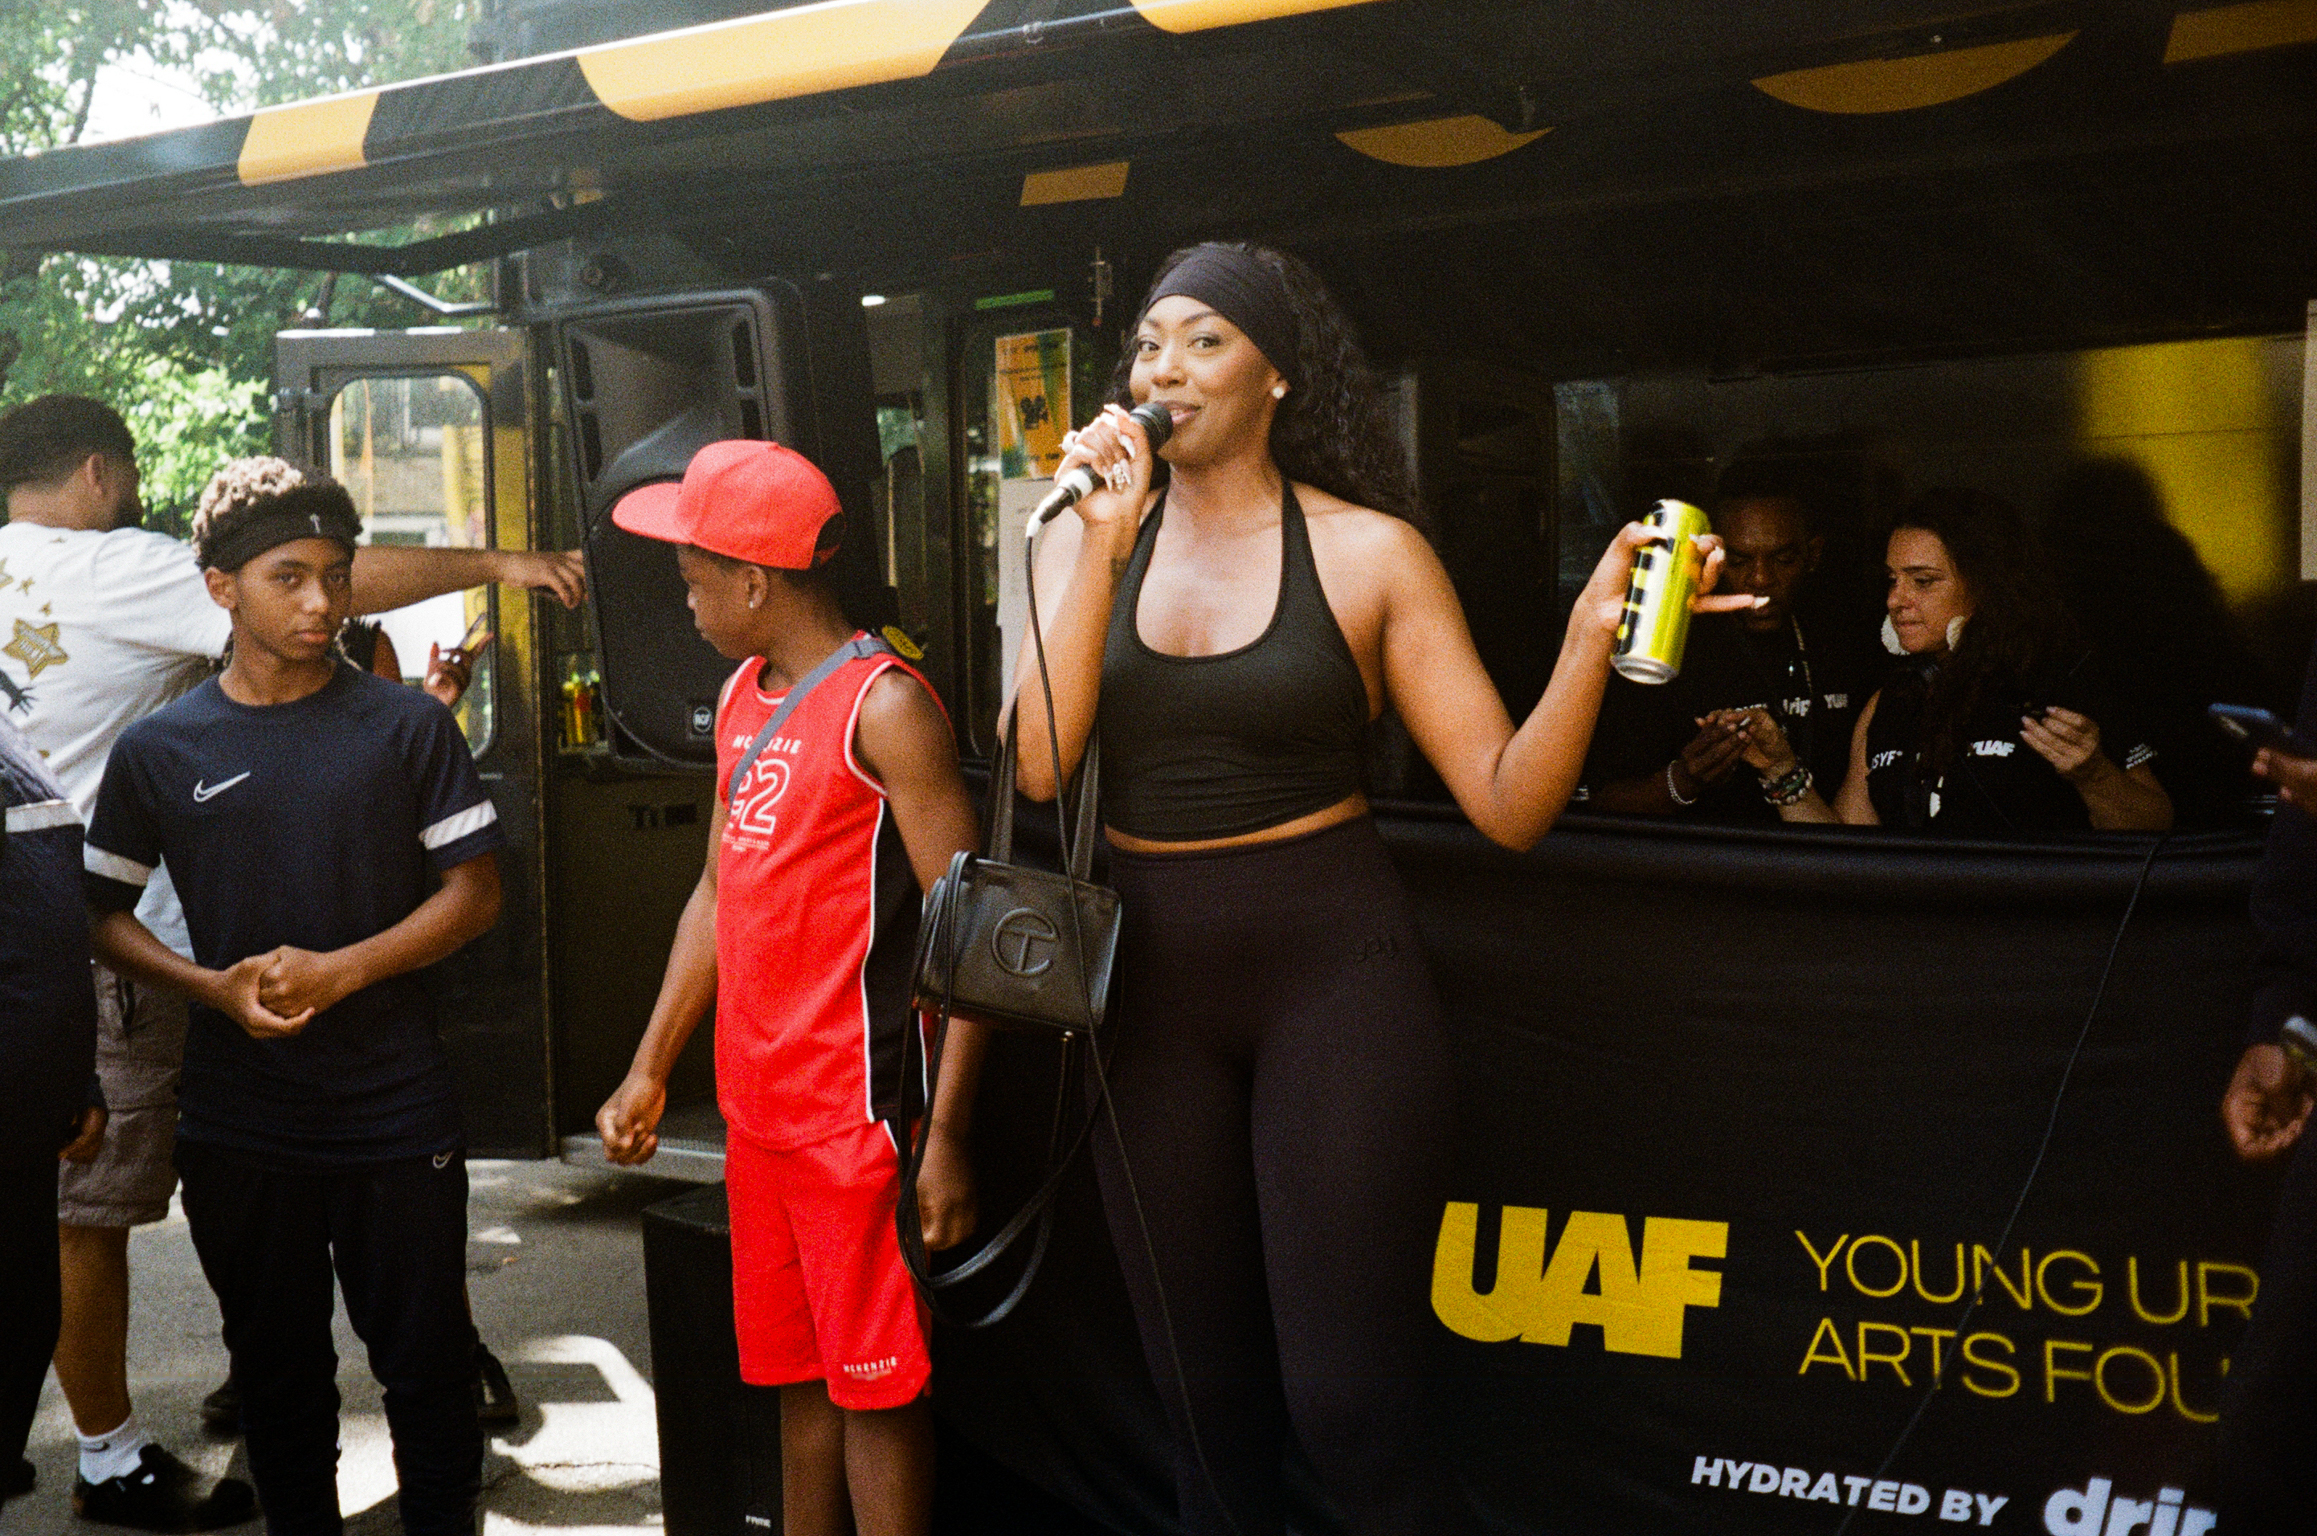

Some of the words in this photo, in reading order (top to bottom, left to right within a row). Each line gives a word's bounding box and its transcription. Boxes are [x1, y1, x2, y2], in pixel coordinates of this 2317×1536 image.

[1795, 1230, 2104, 1316] YOUNG
[1798, 1317, 2021, 1398] ARTS
[1690, 1455, 1931, 1515] HYDRATED
[1939, 1489, 2009, 1526] BY
